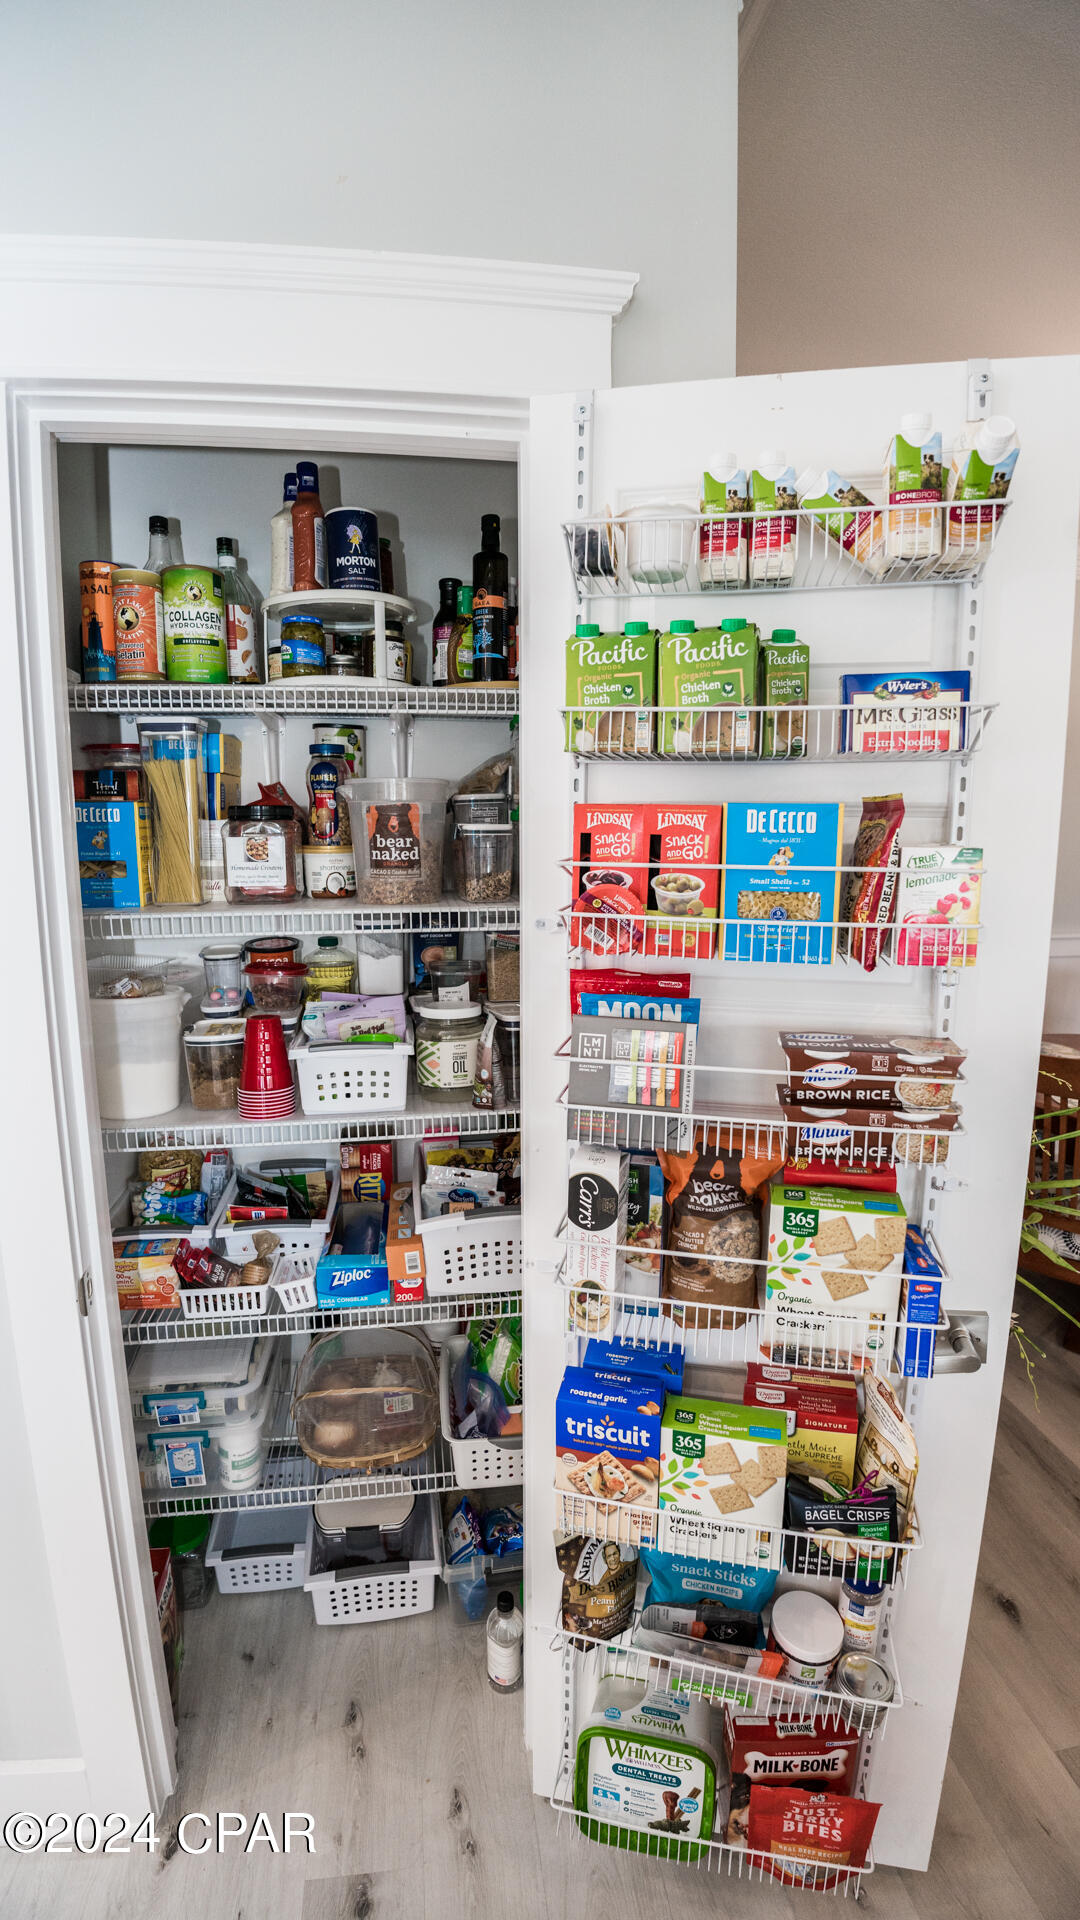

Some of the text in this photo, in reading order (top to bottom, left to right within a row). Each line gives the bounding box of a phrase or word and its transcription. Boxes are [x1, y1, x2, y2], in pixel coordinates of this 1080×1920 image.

[336, 556, 376, 567] MORTON
[169, 611, 221, 624] COLLAGEN
[170, 622, 222, 631] HYDROLYSATE
[571, 638, 648, 666] Pacific
[667, 634, 749, 664] Pacific
[765, 649, 808, 665] Pacific
[584, 673, 612, 683] Organic
[681, 671, 711, 682] Organic
[583, 683, 621, 695] Chicken
[681, 681, 720, 694] Chicken
[771, 679, 800, 687] Chicken
[888, 680, 927, 692] Wyler's
[771, 686, 791, 695] Broth
[584, 694, 610, 705] Broth
[682, 693, 709, 704] Broth
[311, 774, 337, 782] PLANTERS
[90, 807, 120, 822] CECCO
[746, 809, 817, 834] DE CECCO
[376, 834, 413, 847] bear
[372, 847, 419, 860] naked
[912, 854, 937, 865] TRUE
[598, 1001, 682, 1022] MOON
[584, 1037, 600, 1047] LM
[583, 1048, 600, 1057] NT
[452, 1061, 468, 1073] OIL
[796, 1090, 890, 1100] BROWN RICE
[854, 1147, 887, 1156] RCE
[359, 1173, 382, 1200] RITZ
[692, 1179, 735, 1193] bear
[578, 1176, 599, 1229] Carr's
[689, 1191, 739, 1207] naked
[786, 1212, 815, 1228] 365
[332, 1269, 371, 1287] Ziploc
[396, 1293, 413, 1301] 200
[778, 1292, 812, 1304] Organic
[595, 1372, 631, 1383] triscuit
[570, 1388, 628, 1404] roasted garlic
[677, 1411, 694, 1419] 365
[805, 1419, 848, 1429] SIGNATURE
[565, 1417, 650, 1446] triscuit
[675, 1435, 702, 1449] 365
[809, 1442, 837, 1452] Moist
[805, 1451, 843, 1461] SUPREME
[670, 1504, 702, 1516] Organic
[805, 1510, 890, 1521] BAGEL CRISPS
[670, 1516, 705, 1529] Wheat
[672, 1564, 756, 1587] Snack Sticks
[686, 1580, 739, 1597] CHICKEN RECIPE
[605, 1737, 693, 1772] WHIMZEES
[617, 1765, 677, 1784] DENTAL TREATS
[792, 1806, 837, 1816] JUST
[784, 1811, 844, 1828] JERKY
[783, 1820, 842, 1842] BITES
